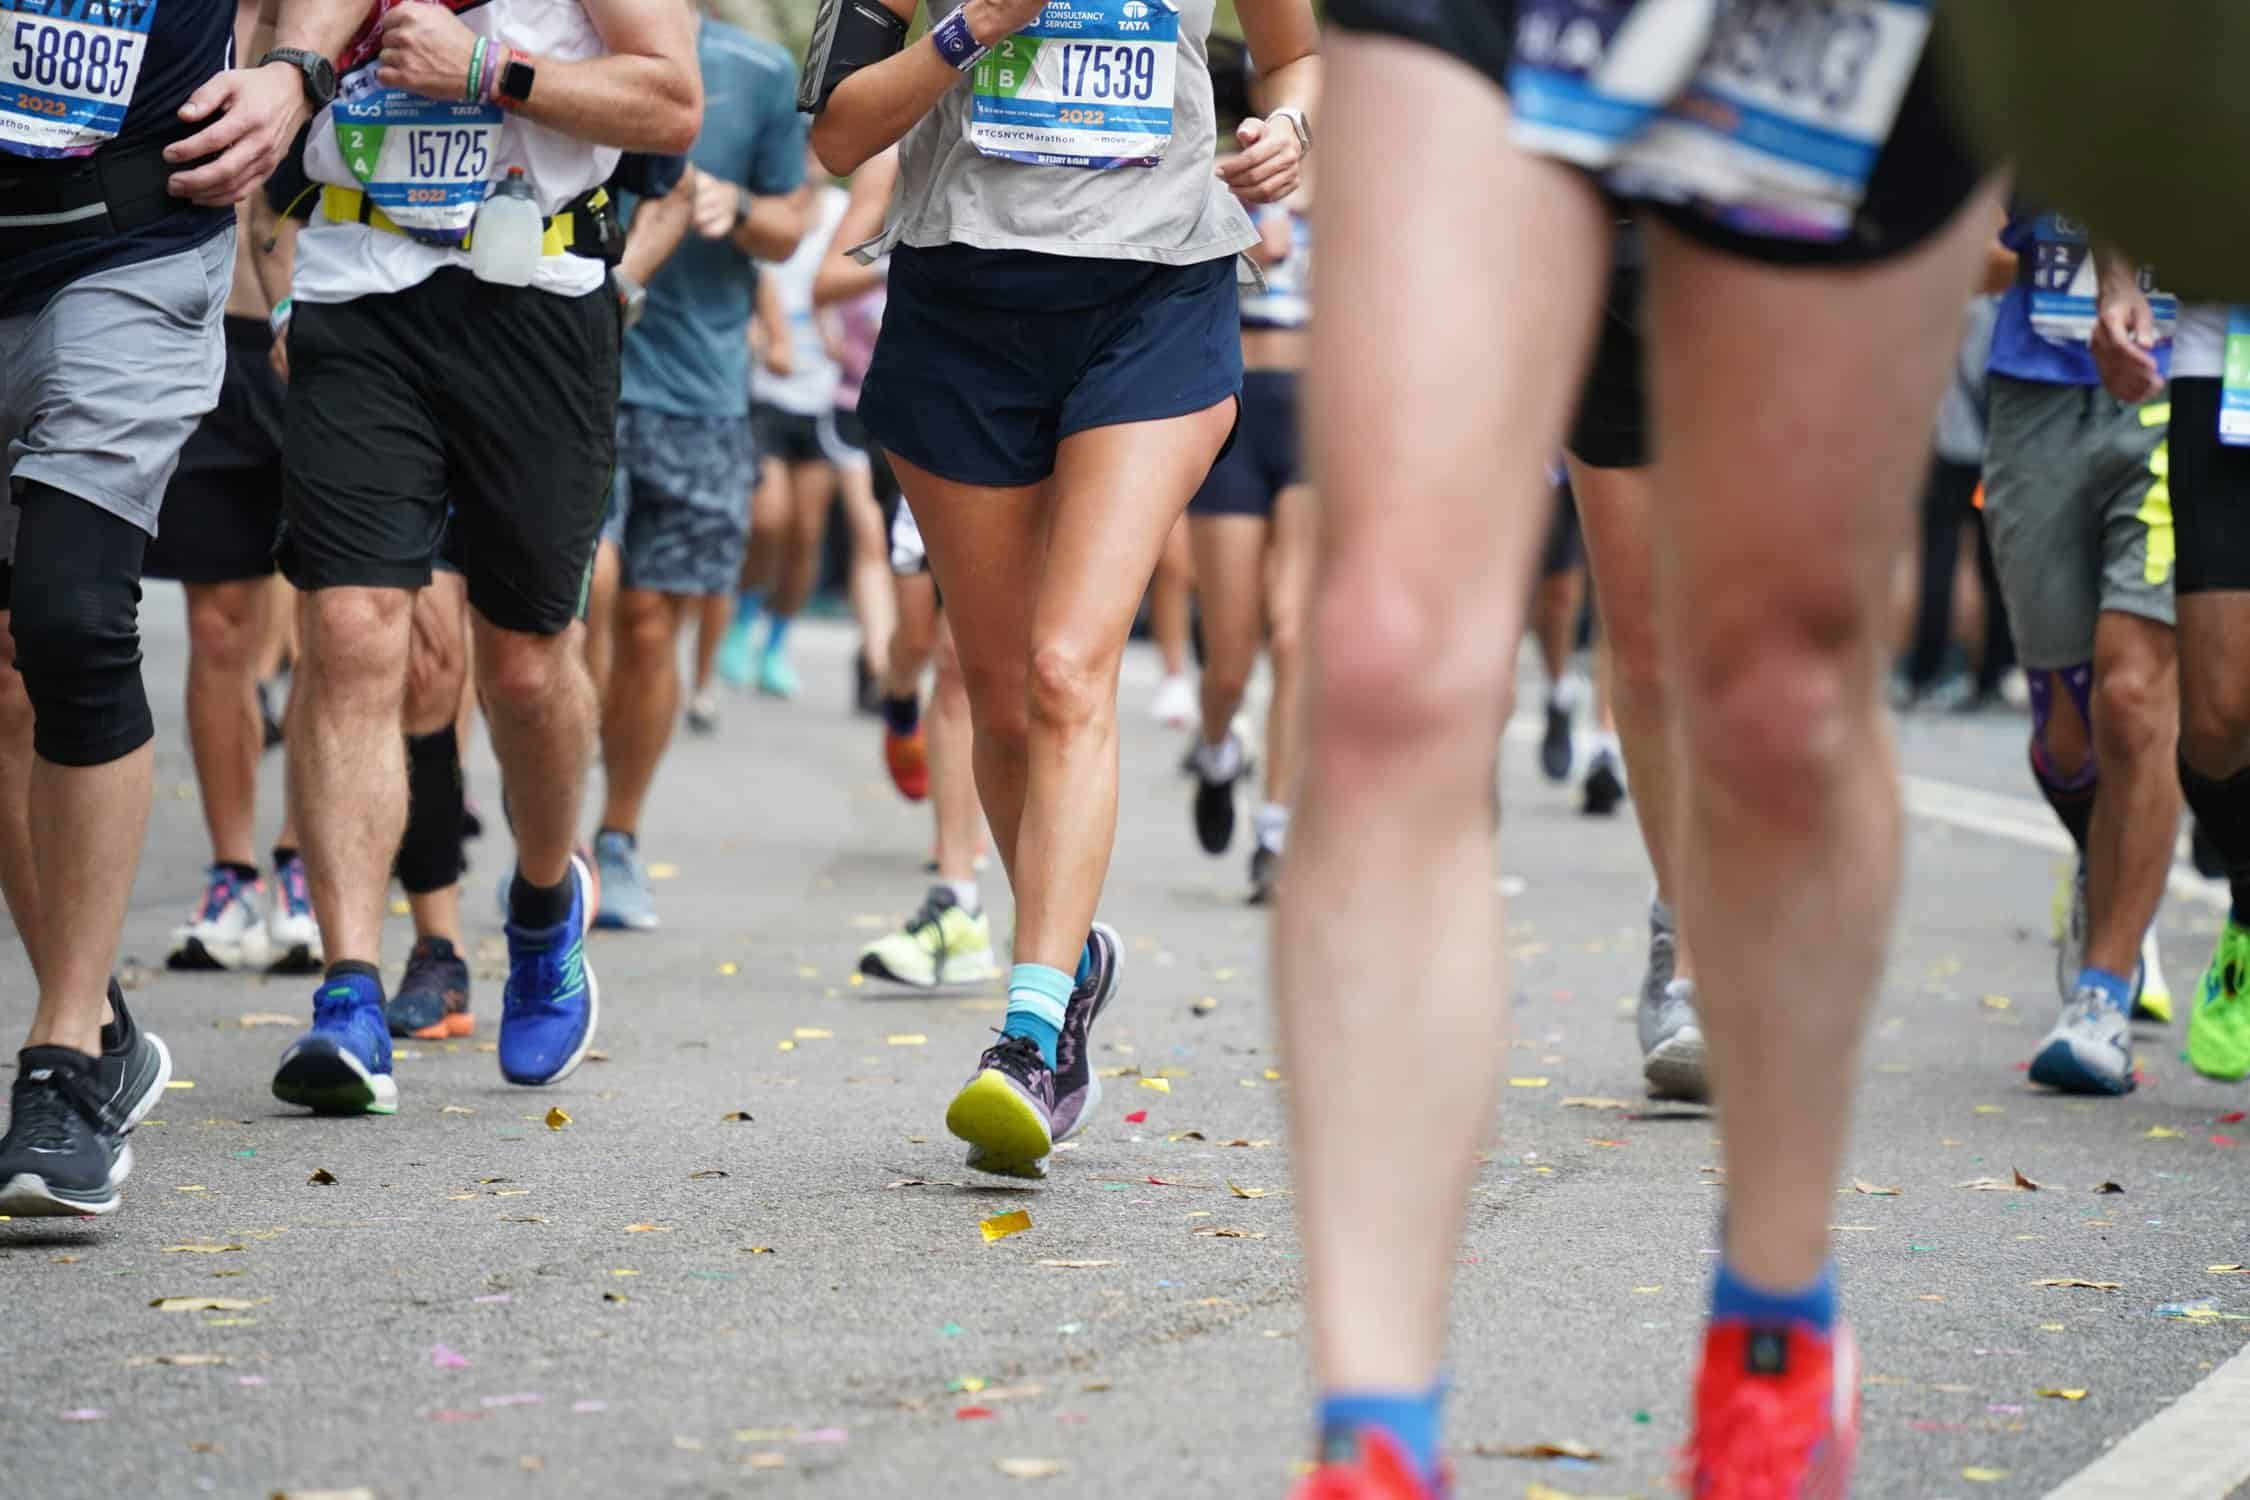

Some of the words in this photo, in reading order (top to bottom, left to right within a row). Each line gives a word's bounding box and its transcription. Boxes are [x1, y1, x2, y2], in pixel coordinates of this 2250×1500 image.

[1047, 1, 1072, 10] TATA
[1044, 19, 1083, 30] SERVICES
[1045, 10, 1105, 21] CONSULTANCY
[1118, 20, 1151, 32] TATA
[1001, 39, 1015, 58] 2
[12, 20, 135, 97] 58885
[999, 69, 1015, 89] B
[1062, 44, 1155, 100] 17539
[16, 92, 68, 117] 2022
[1057, 108, 1106, 126] 2022
[351, 130, 364, 149] 2
[408, 130, 488, 178] 15725
[353, 158, 369, 174] A
[407, 188, 448, 203] 2022
